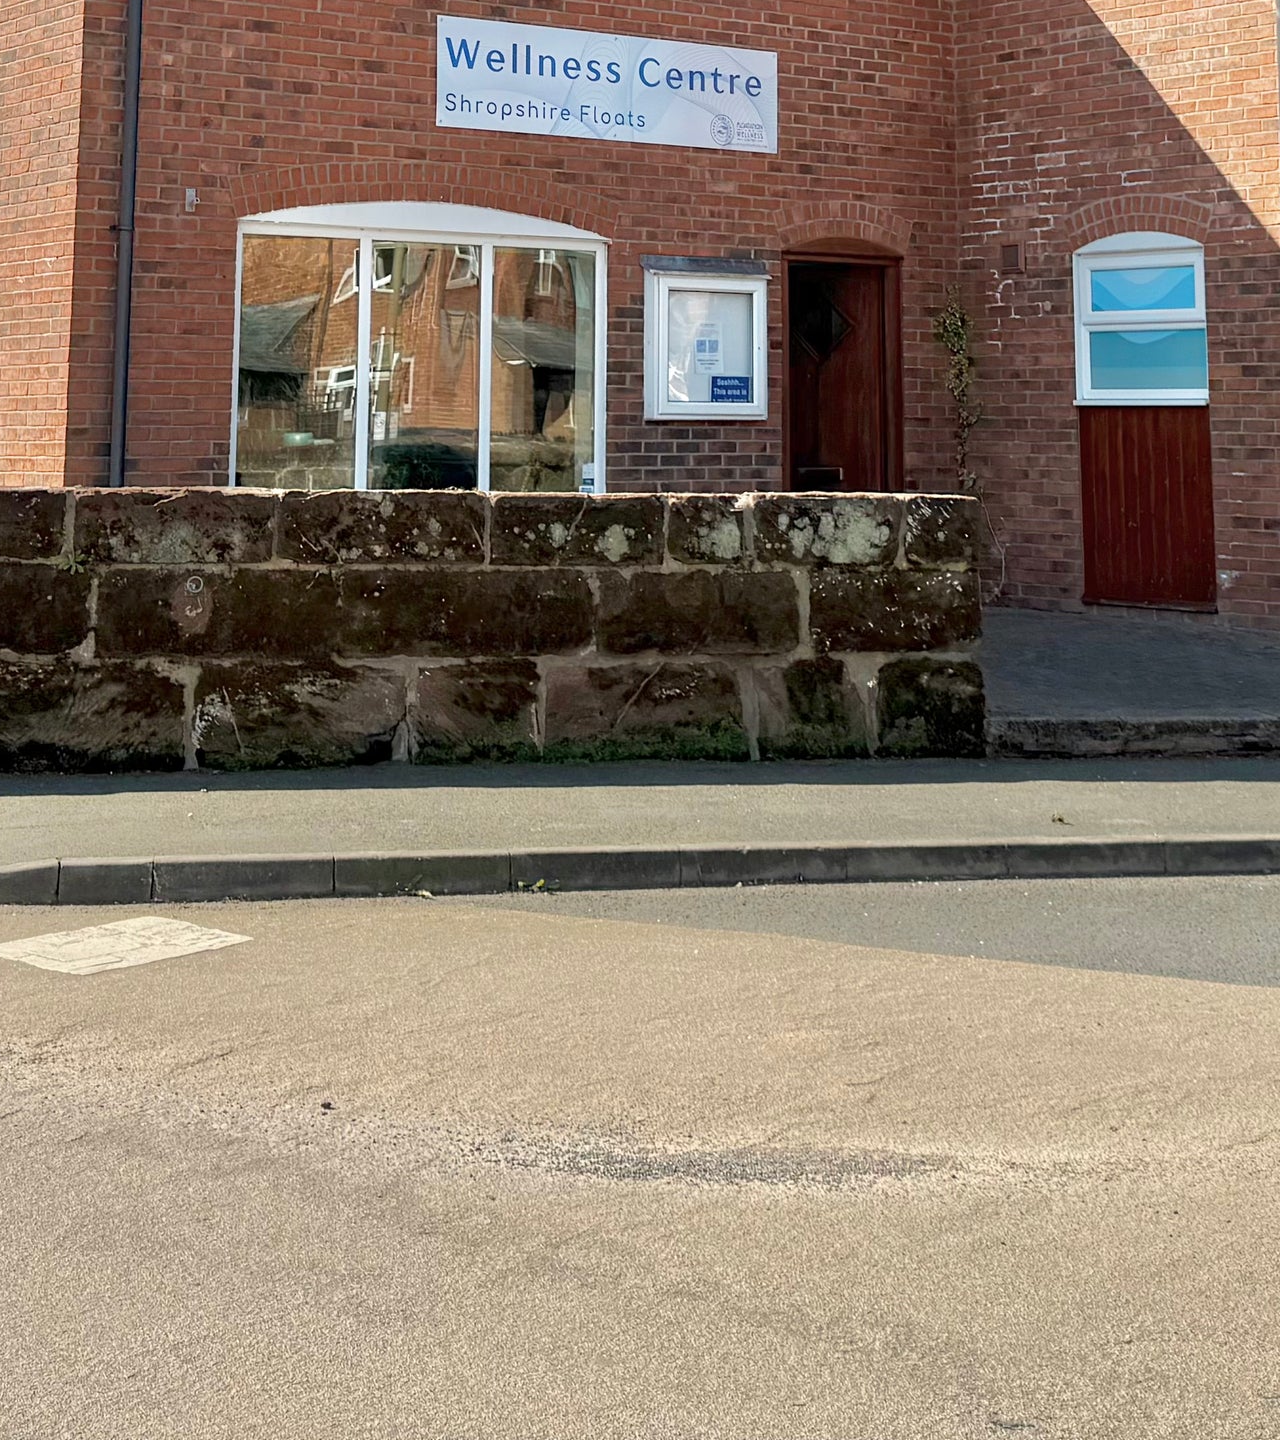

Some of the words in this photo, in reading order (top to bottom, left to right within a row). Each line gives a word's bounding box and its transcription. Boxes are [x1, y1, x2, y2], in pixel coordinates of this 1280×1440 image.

[445, 37, 621, 84] Wellness
[638, 57, 762, 97] Centre
[445, 92, 571, 121] Shropshire
[580, 105, 646, 128] Floats
